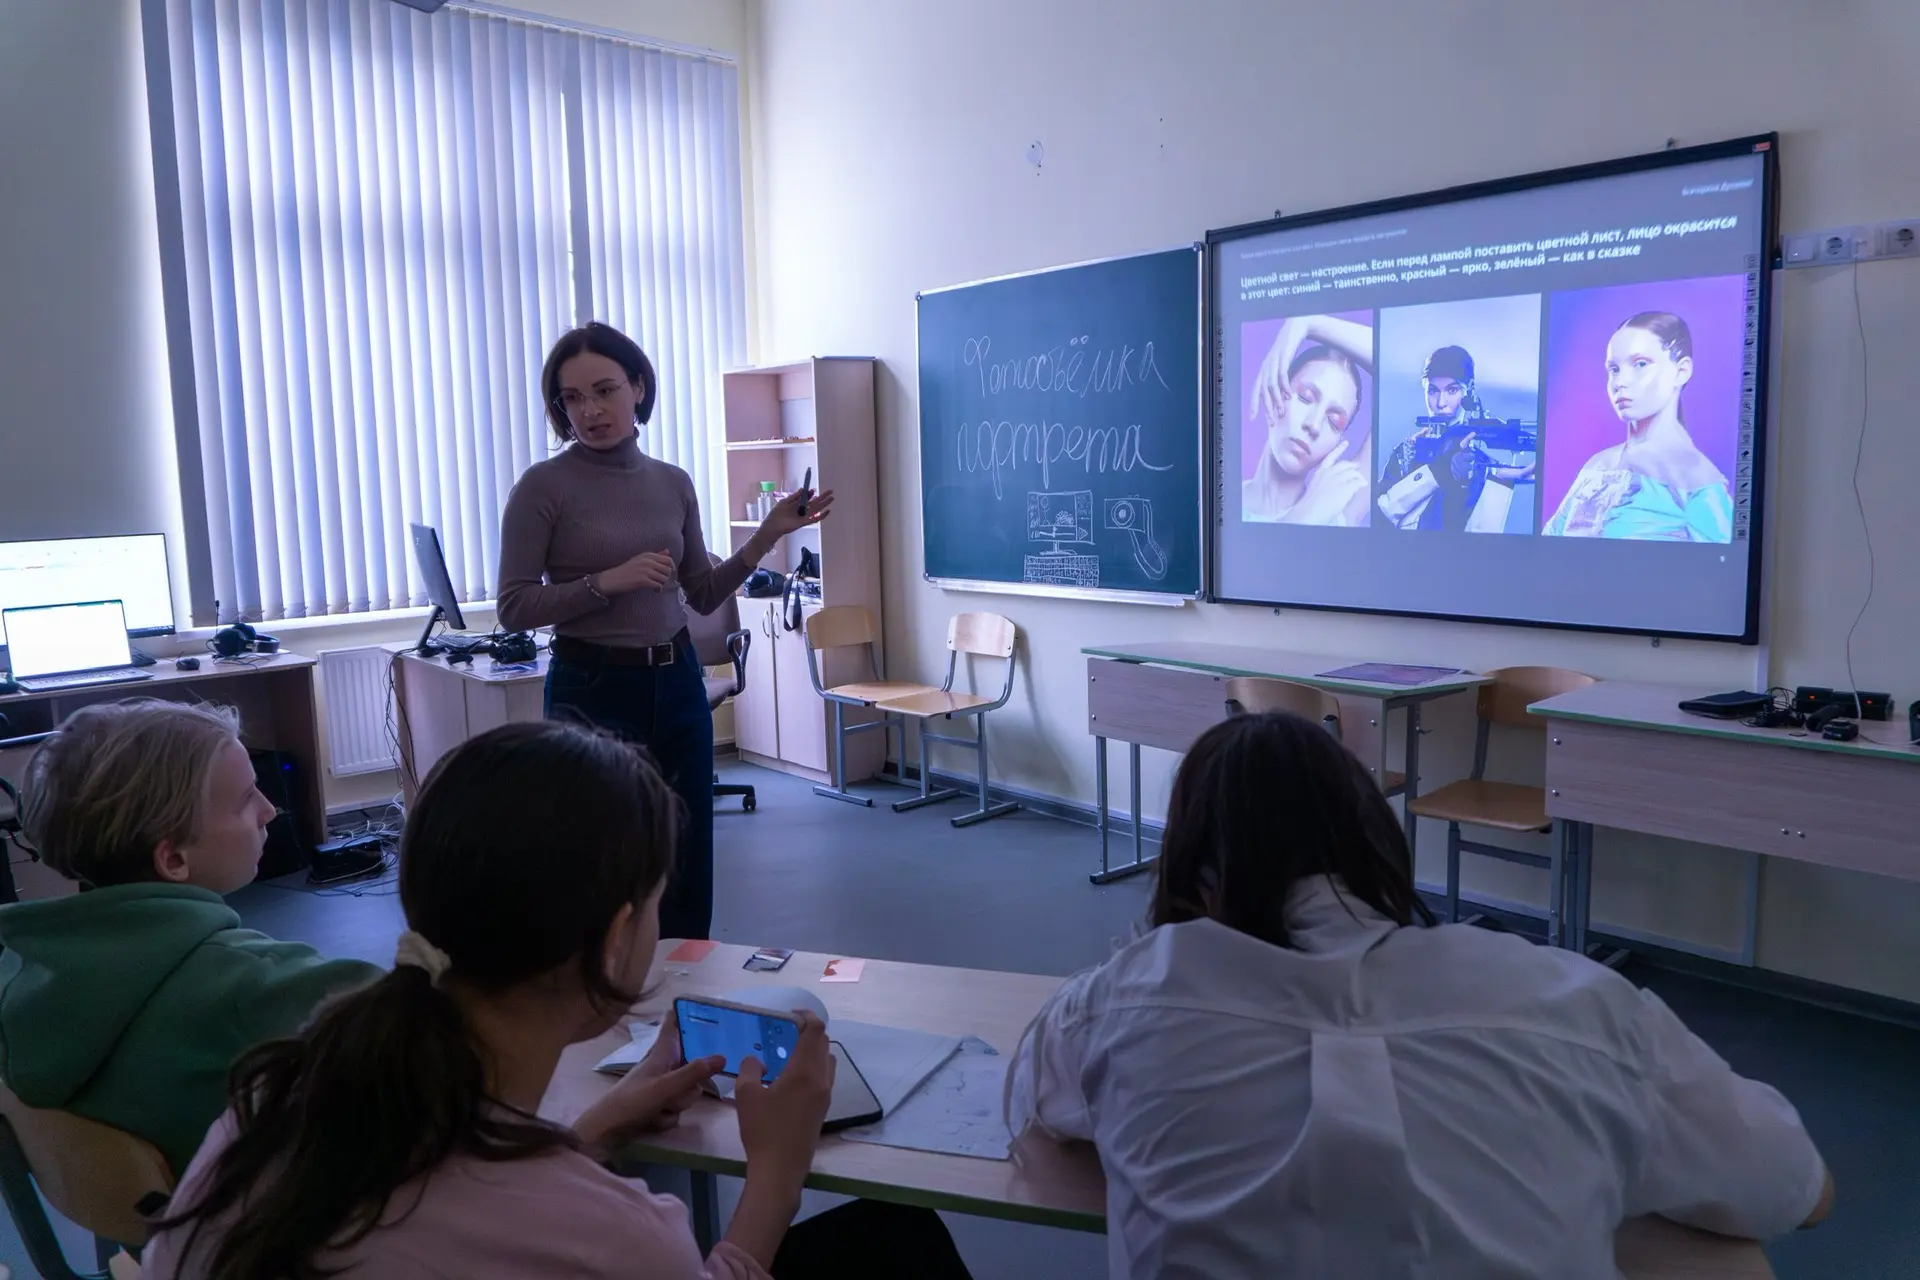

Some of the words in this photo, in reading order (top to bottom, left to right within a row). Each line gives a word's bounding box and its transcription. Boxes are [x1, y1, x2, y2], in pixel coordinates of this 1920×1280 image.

[1240, 272, 1278, 289] Цветной
[1279, 271, 1300, 283] свет
[1311, 262, 1370, 278] настроение.
[1371, 258, 1395, 270] Если
[1396, 253, 1429, 268] перед
[1429, 246, 1473, 262] лампой
[1474, 240, 1535, 258] поставить
[1536, 230, 1589, 252] цветной
[1590, 228, 1625, 244] лист,
[1626, 224, 1663, 240] лицо
[1663, 215, 1738, 237] окрасится
[1247, 290, 1267, 300] этот
[1267, 287, 1291, 299] цвет:
[1291, 280, 1321, 295] синий
[1334, 272, 1399, 290] таинственно,
[1400, 265, 1447, 284] красный
[1461, 262, 1492, 276] ярко,
[1493, 252, 1546, 271] зелёный
[1562, 251, 1585, 263] как
[1586, 249, 1597, 261] в
[1597, 244, 1642, 260] сказке
[957, 419, 1174, 501] портрета
